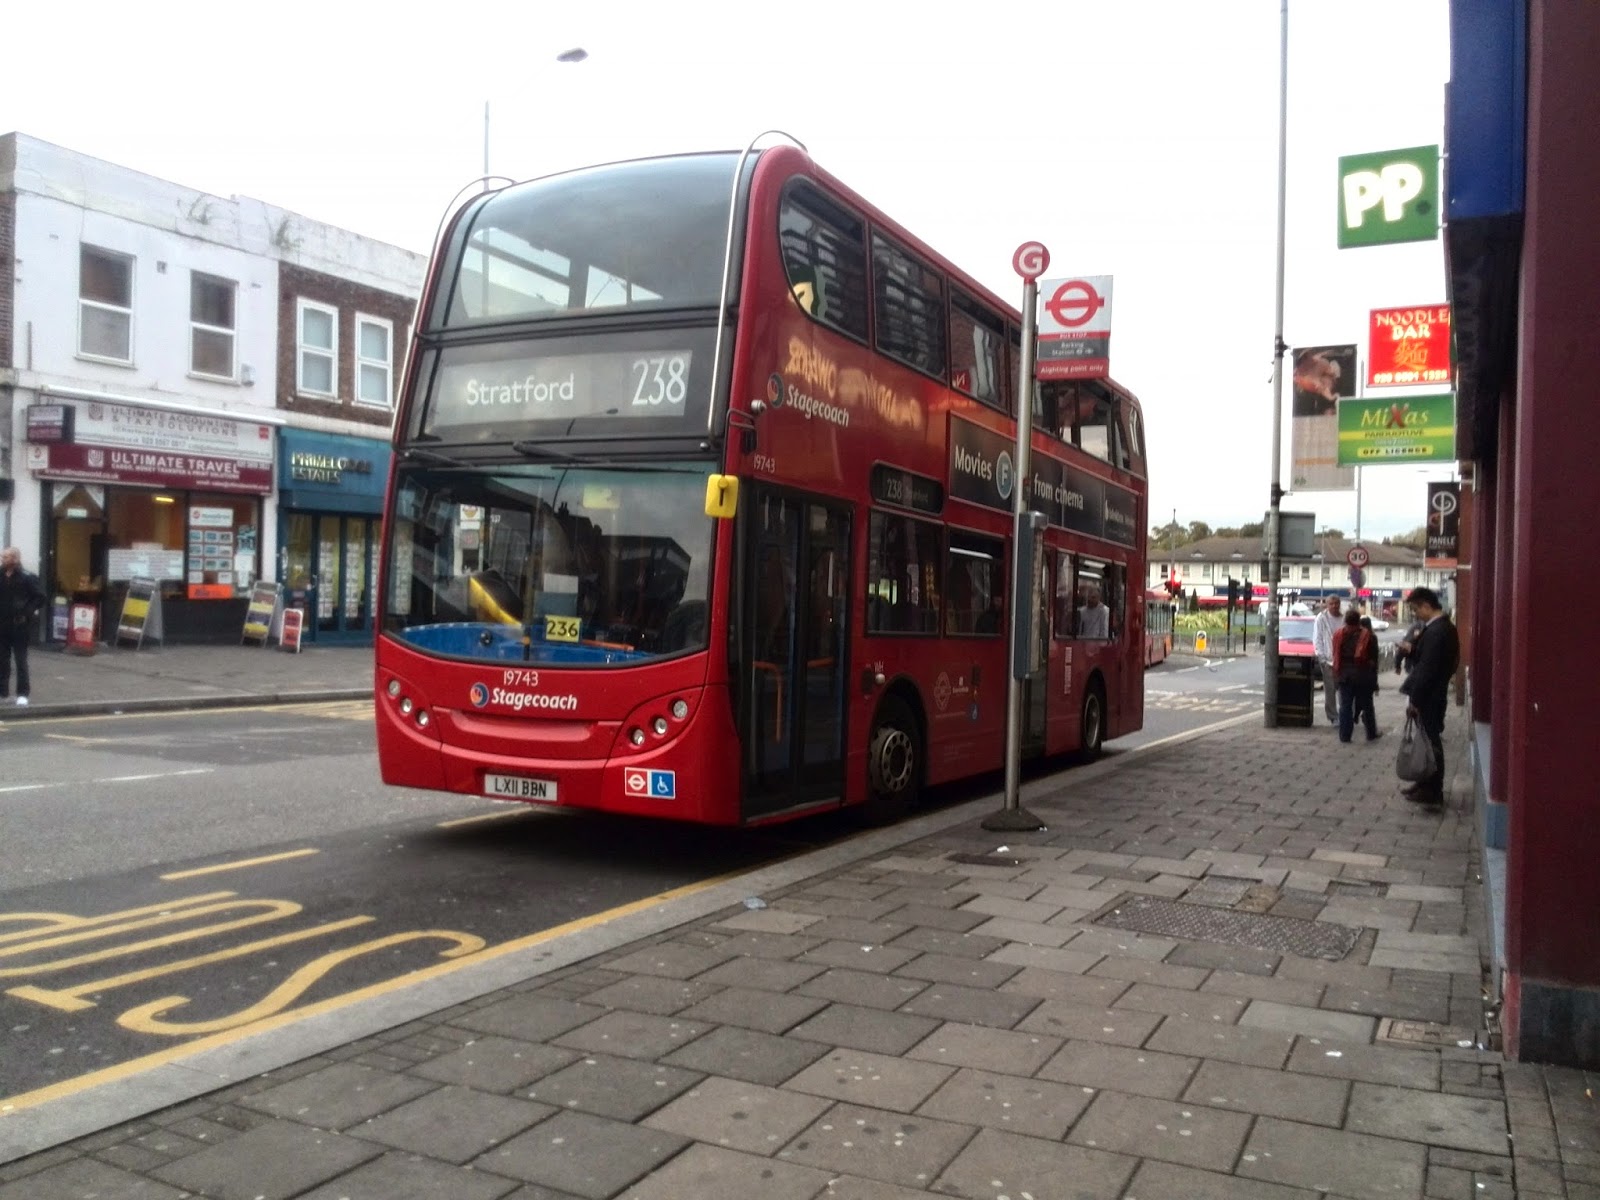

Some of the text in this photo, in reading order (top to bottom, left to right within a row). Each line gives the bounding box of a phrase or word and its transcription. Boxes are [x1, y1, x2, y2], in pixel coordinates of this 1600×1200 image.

[1019, 246, 1043, 275] G
[1375, 308, 1448, 327] NOODLE
[1392, 323, 1431, 341] BAR
[1041, 364, 1103, 374] Alighting point only
[466, 356, 686, 406] Stratford 238
[111, 406, 165, 420] ULTIMATE
[786, 384, 850, 428] Stagecoach
[126, 416, 151, 426] TAX
[158, 420, 237, 437] SOLUTIONS
[111, 450, 184, 469] ULTIMATE
[188, 458, 240, 474] TRAVEL
[753, 454, 776, 473] 19743
[954, 444, 992, 481] Movies
[292, 468, 341, 484] ESTATES
[1001, 464, 1009, 486] F
[886, 478, 902, 499] 238
[1033, 473, 1053, 501] from
[1055, 483, 1084, 510] cinema
[1350, 552, 1367, 562] 30
[546, 619, 579, 638] 236
[503, 670, 539, 687] 19743
[491, 687, 578, 711] Stagecoach
[494, 777, 547, 798] LX11 BBN
